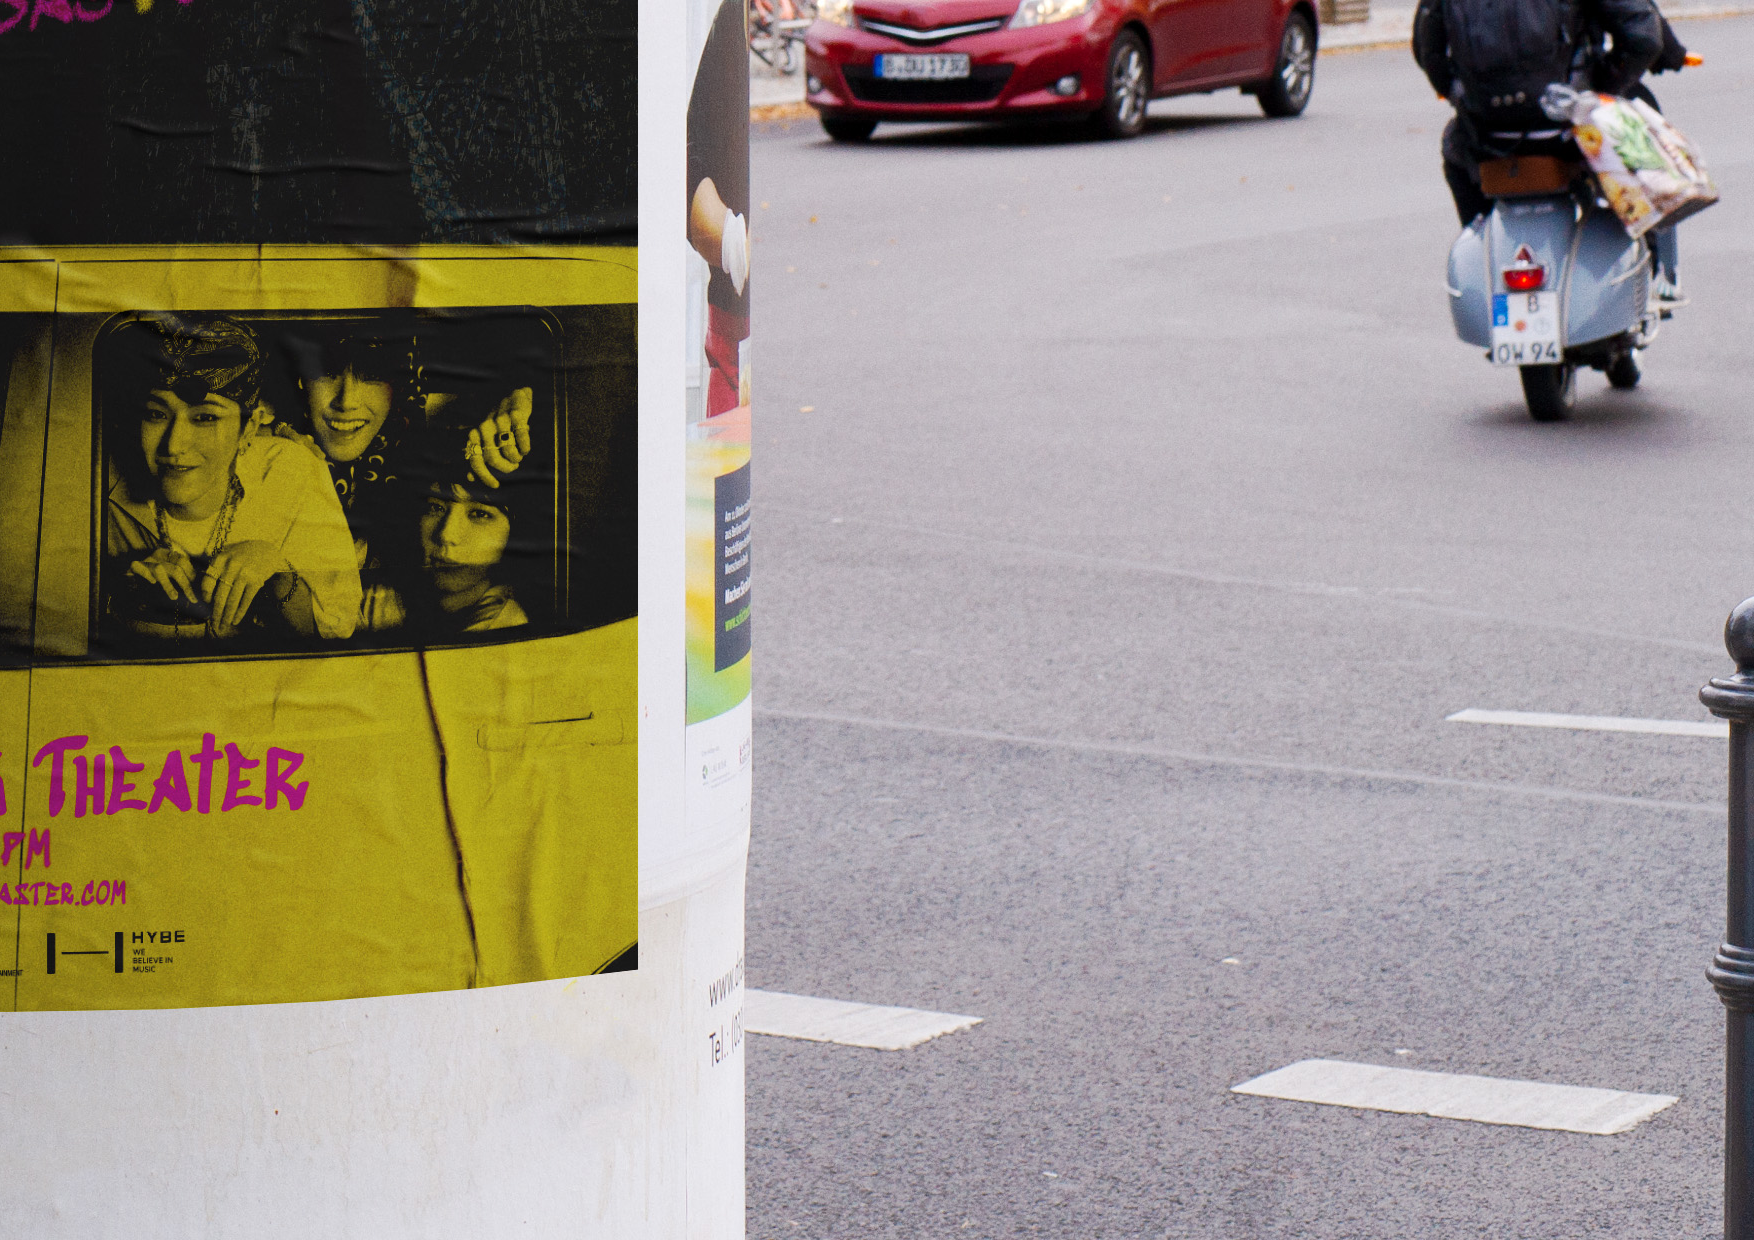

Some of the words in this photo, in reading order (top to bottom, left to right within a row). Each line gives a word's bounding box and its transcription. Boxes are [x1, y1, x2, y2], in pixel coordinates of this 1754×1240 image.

[1527, 294, 1539, 313] B
[1531, 342, 1557, 361] 94
[32, 732, 309, 818] THEATER
[1, 828, 51, 869] PM
[132, 930, 185, 944] HYBE
[133, 948, 145, 956] WE
[133, 956, 163, 964] BELIEVE
[164, 956, 174, 964] IN
[133, 965, 156, 973] MUSIC
[709, 1024, 729, 1067] Tel.:
